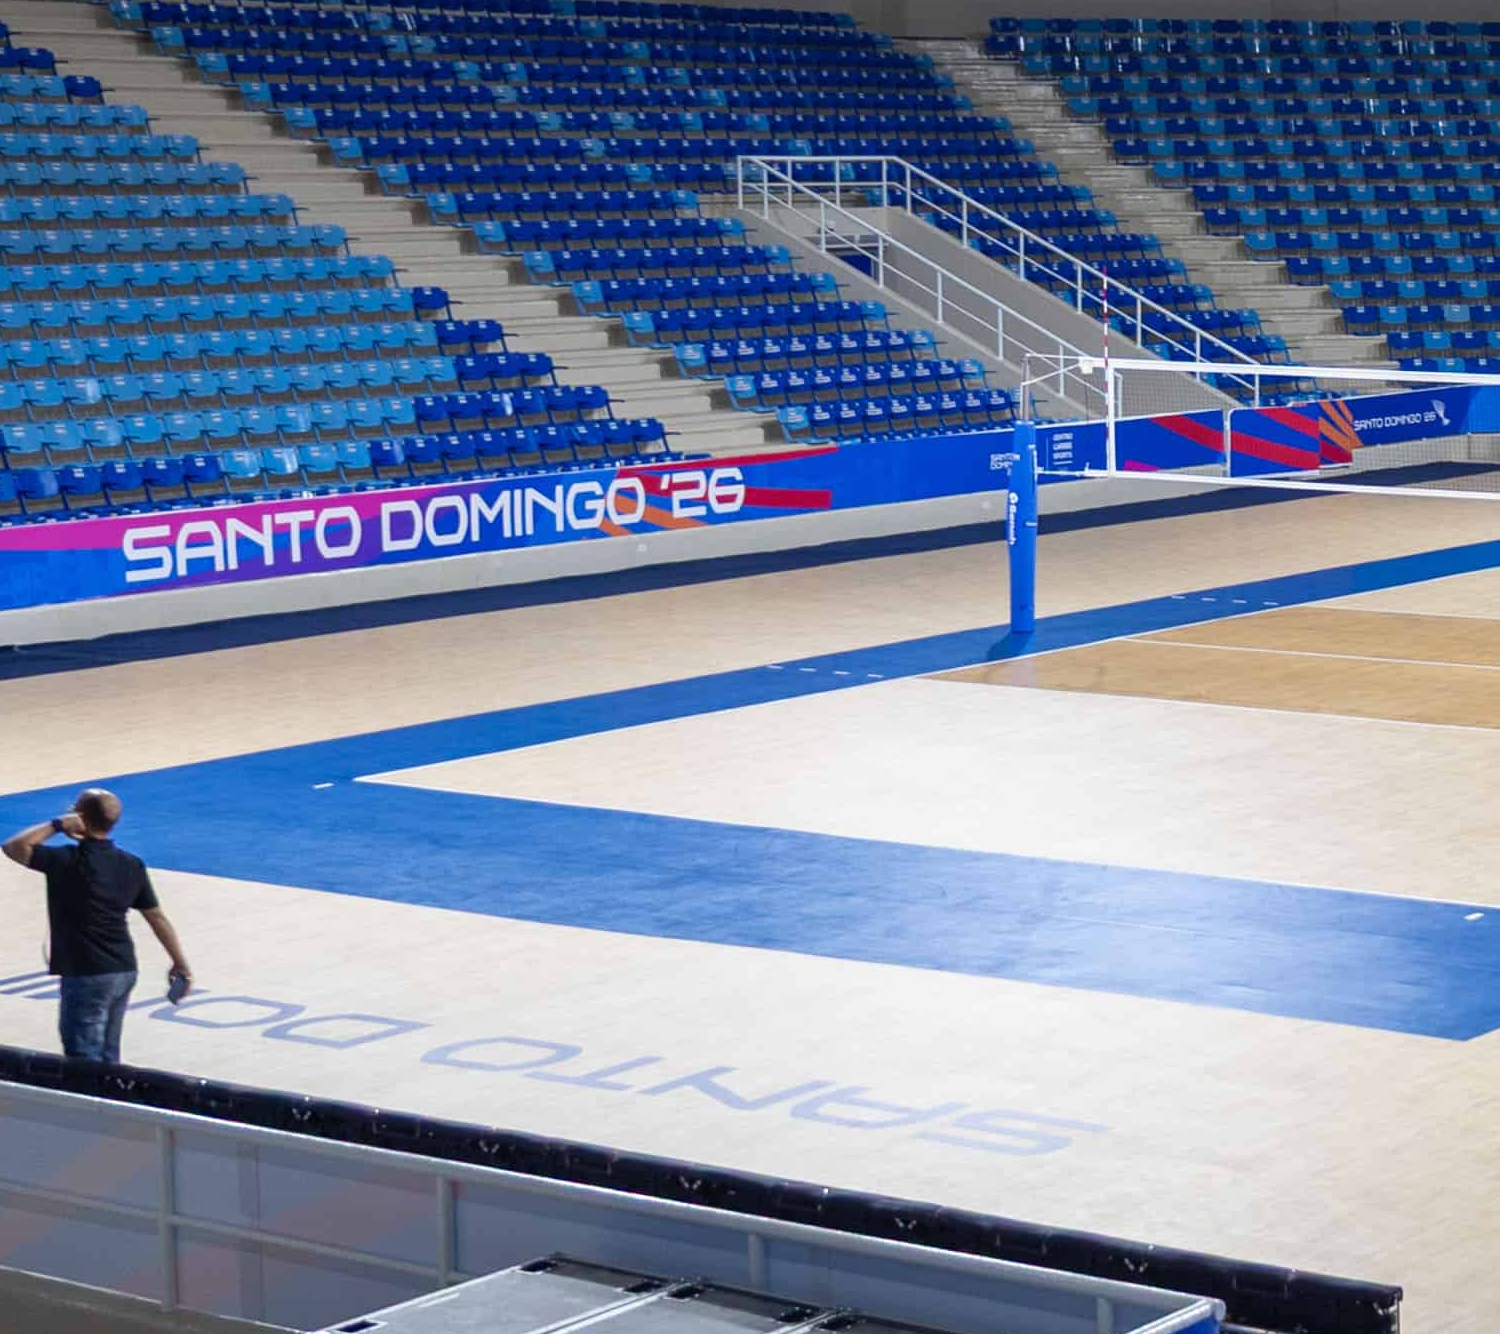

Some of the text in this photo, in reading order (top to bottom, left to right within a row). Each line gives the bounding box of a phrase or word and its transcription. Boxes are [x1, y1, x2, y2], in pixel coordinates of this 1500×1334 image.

[123, 467, 746, 583] SANTO DOMINGO '26
[420, 1034, 1112, 1157] SANTO
